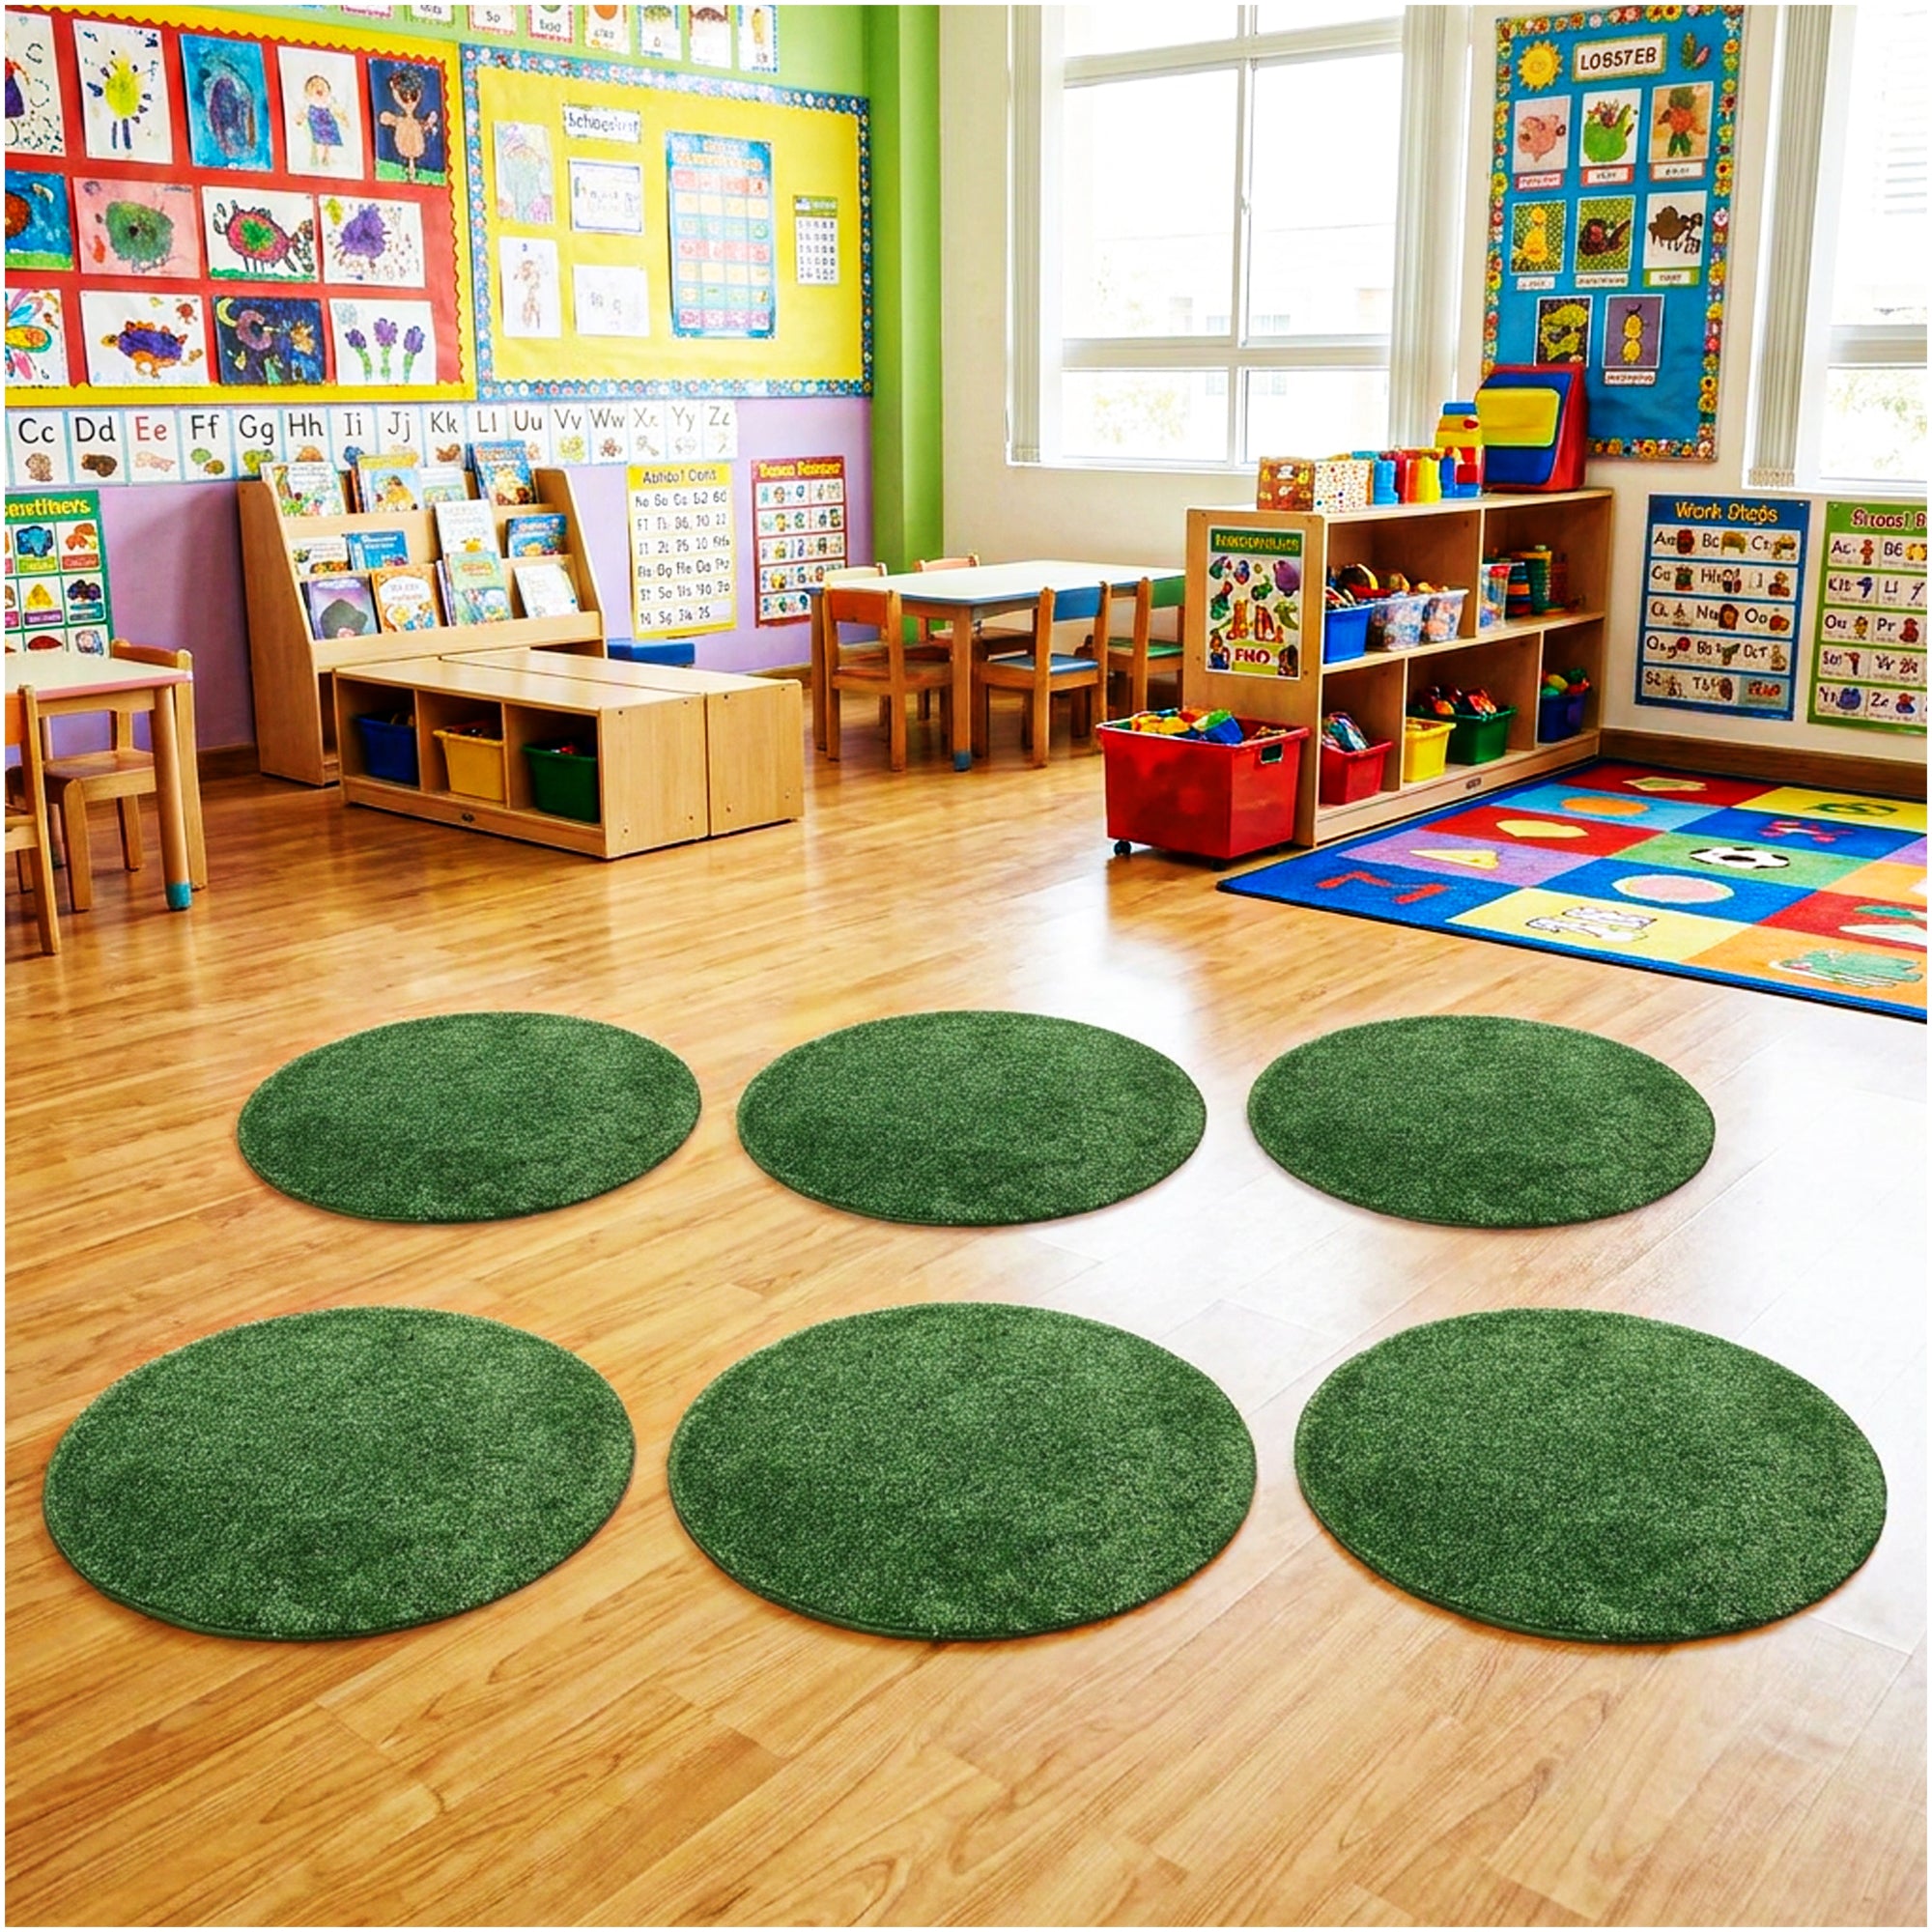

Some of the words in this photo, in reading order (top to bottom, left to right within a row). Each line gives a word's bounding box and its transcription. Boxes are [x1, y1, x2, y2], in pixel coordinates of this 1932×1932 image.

[18, 417, 55, 443] Cc
[75, 416, 116, 442] Dd
[135, 416, 167, 441] Ee
[191, 414, 219, 440] Ff
[239, 414, 274, 445] Gg
[289, 412, 324, 437] Hh
[344, 412, 362, 437] Ii
[388, 412, 411, 442] Jj
[431, 411, 458, 434] Kk
[514, 410, 543, 431] Uu
[554, 409, 582, 430] Vv
[589, 408, 626, 429] Ww
[671, 406, 696, 433] Yy
